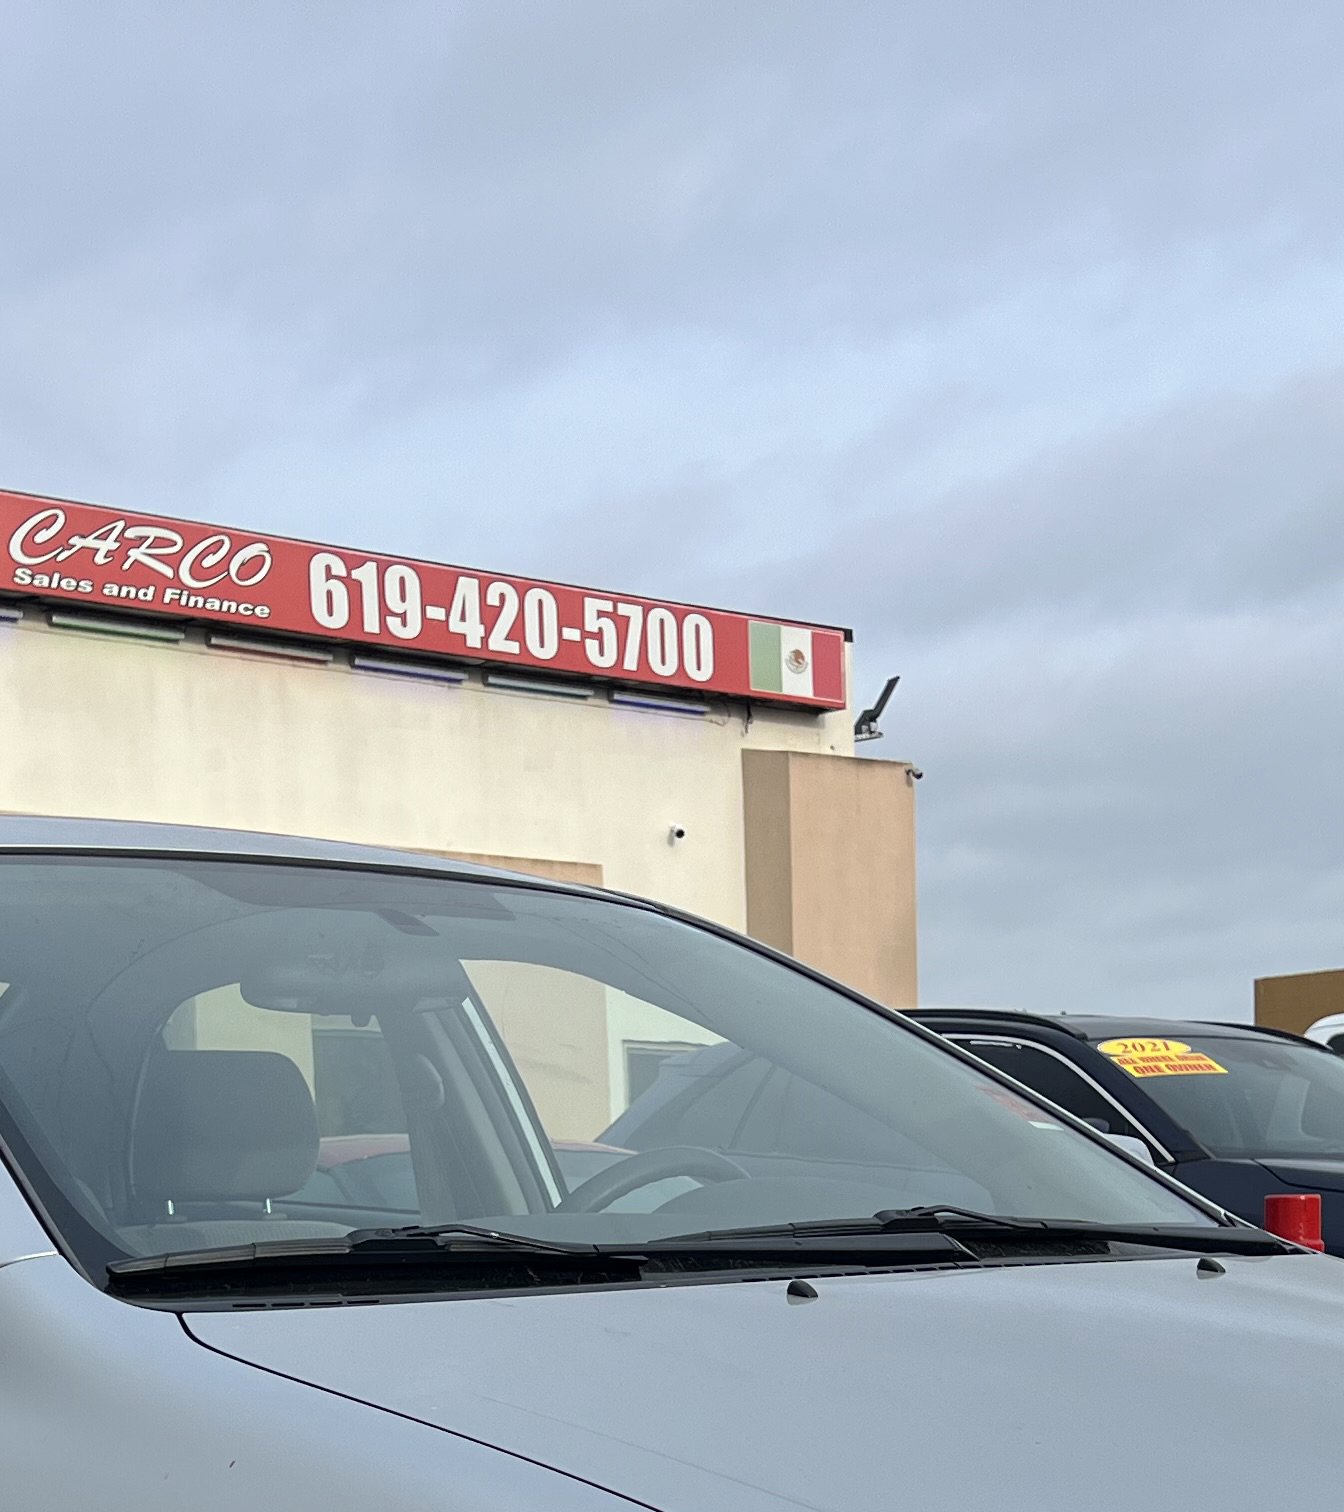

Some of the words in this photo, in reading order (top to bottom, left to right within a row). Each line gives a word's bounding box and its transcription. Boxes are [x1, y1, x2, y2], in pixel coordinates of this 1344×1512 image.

[8, 508, 273, 588] CARCO
[12, 567, 93, 593] Sales
[102, 582, 157, 602] and
[163, 588, 271, 618] Finance
[308, 552, 715, 682] 619-420-5700
[1117, 1040, 1172, 1054] 2021
[1133, 1064, 1162, 1075] ONE
[1164, 1063, 1218, 1073] OWNER
